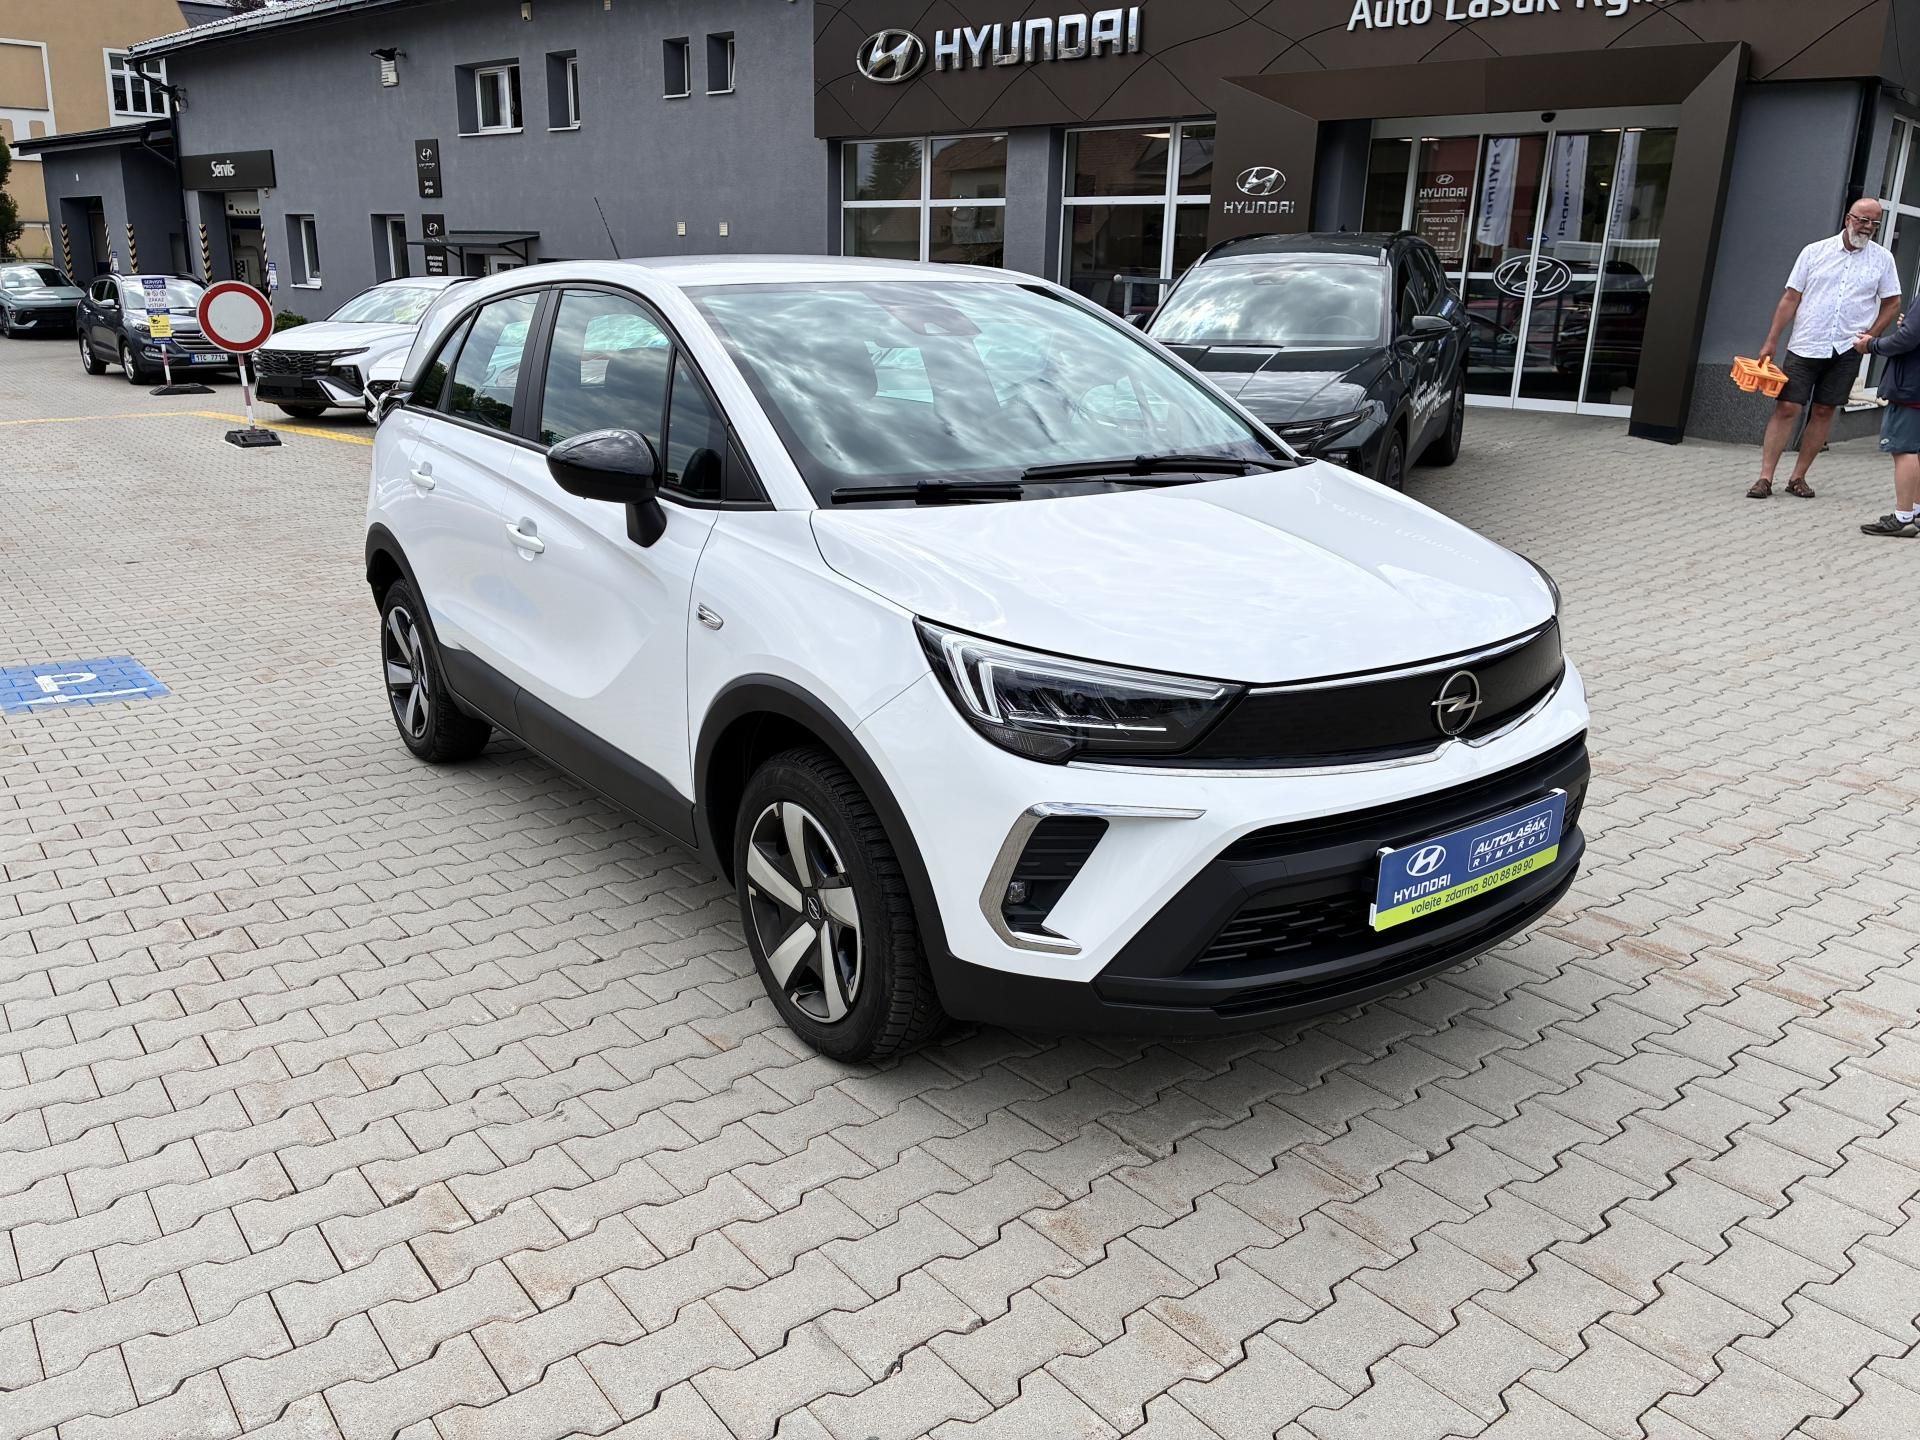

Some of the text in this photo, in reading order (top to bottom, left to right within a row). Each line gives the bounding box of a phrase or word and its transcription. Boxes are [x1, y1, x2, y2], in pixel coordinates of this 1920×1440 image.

[1346, 0, 1431, 31] Auto
[935, 6, 1142, 71] HYUNDAI
[211, 160, 235, 177] Servis
[1223, 201, 1295, 214] HYUNDAI
[1419, 187, 1468, 198] HYUNDAI
[34, 672, 97, 693] P
[1474, 817, 1548, 855] AUTOLAŠÁK
[1393, 873, 1451, 904] HYUNDAI
[1411, 858, 1534, 915] volejte zdarma 800 88 89 90
